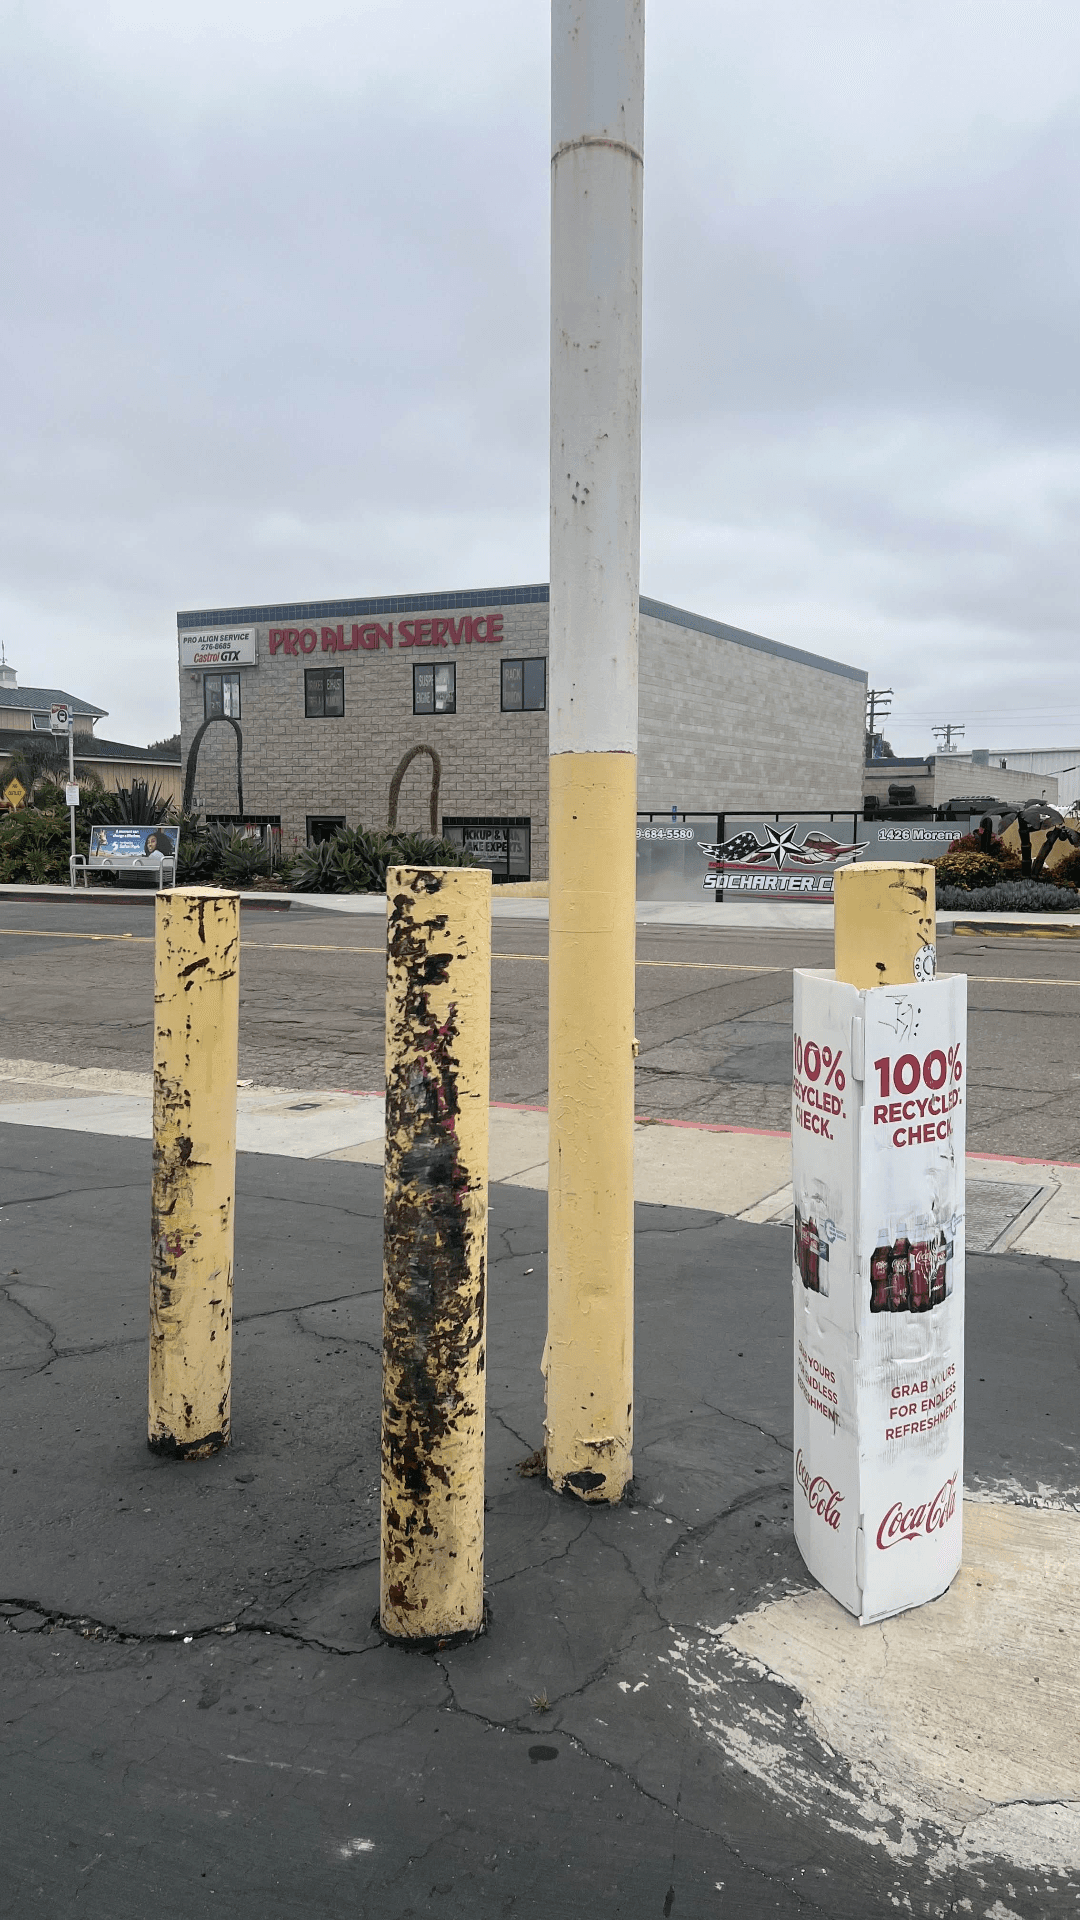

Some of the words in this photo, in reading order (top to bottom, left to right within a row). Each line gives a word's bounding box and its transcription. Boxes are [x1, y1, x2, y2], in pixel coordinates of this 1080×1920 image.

[183, 636, 197, 644] PRO
[198, 635, 219, 643] ALIGN
[220, 633, 249, 641] SERVICE
[269, 628, 317, 656] PRO
[321, 622, 394, 654] ALIGN
[398, 614, 504, 649] SERVICE
[193, 652, 220, 663] Castrol
[220, 651, 241, 661] GTX
[878, 827, 911, 841] 1426
[912, 827, 962, 841] Morena
[703, 873, 834, 892] SOCHARTER.C
[794, 1032, 846, 1092] 100%
[874, 1043, 962, 1098] 100%
[808, 1355, 836, 1385] YOURS
[889, 1403, 917, 1420] FOR
[921, 1381, 957, 1412] ENDLESS
[891, 1380, 928, 1399] GRAB
